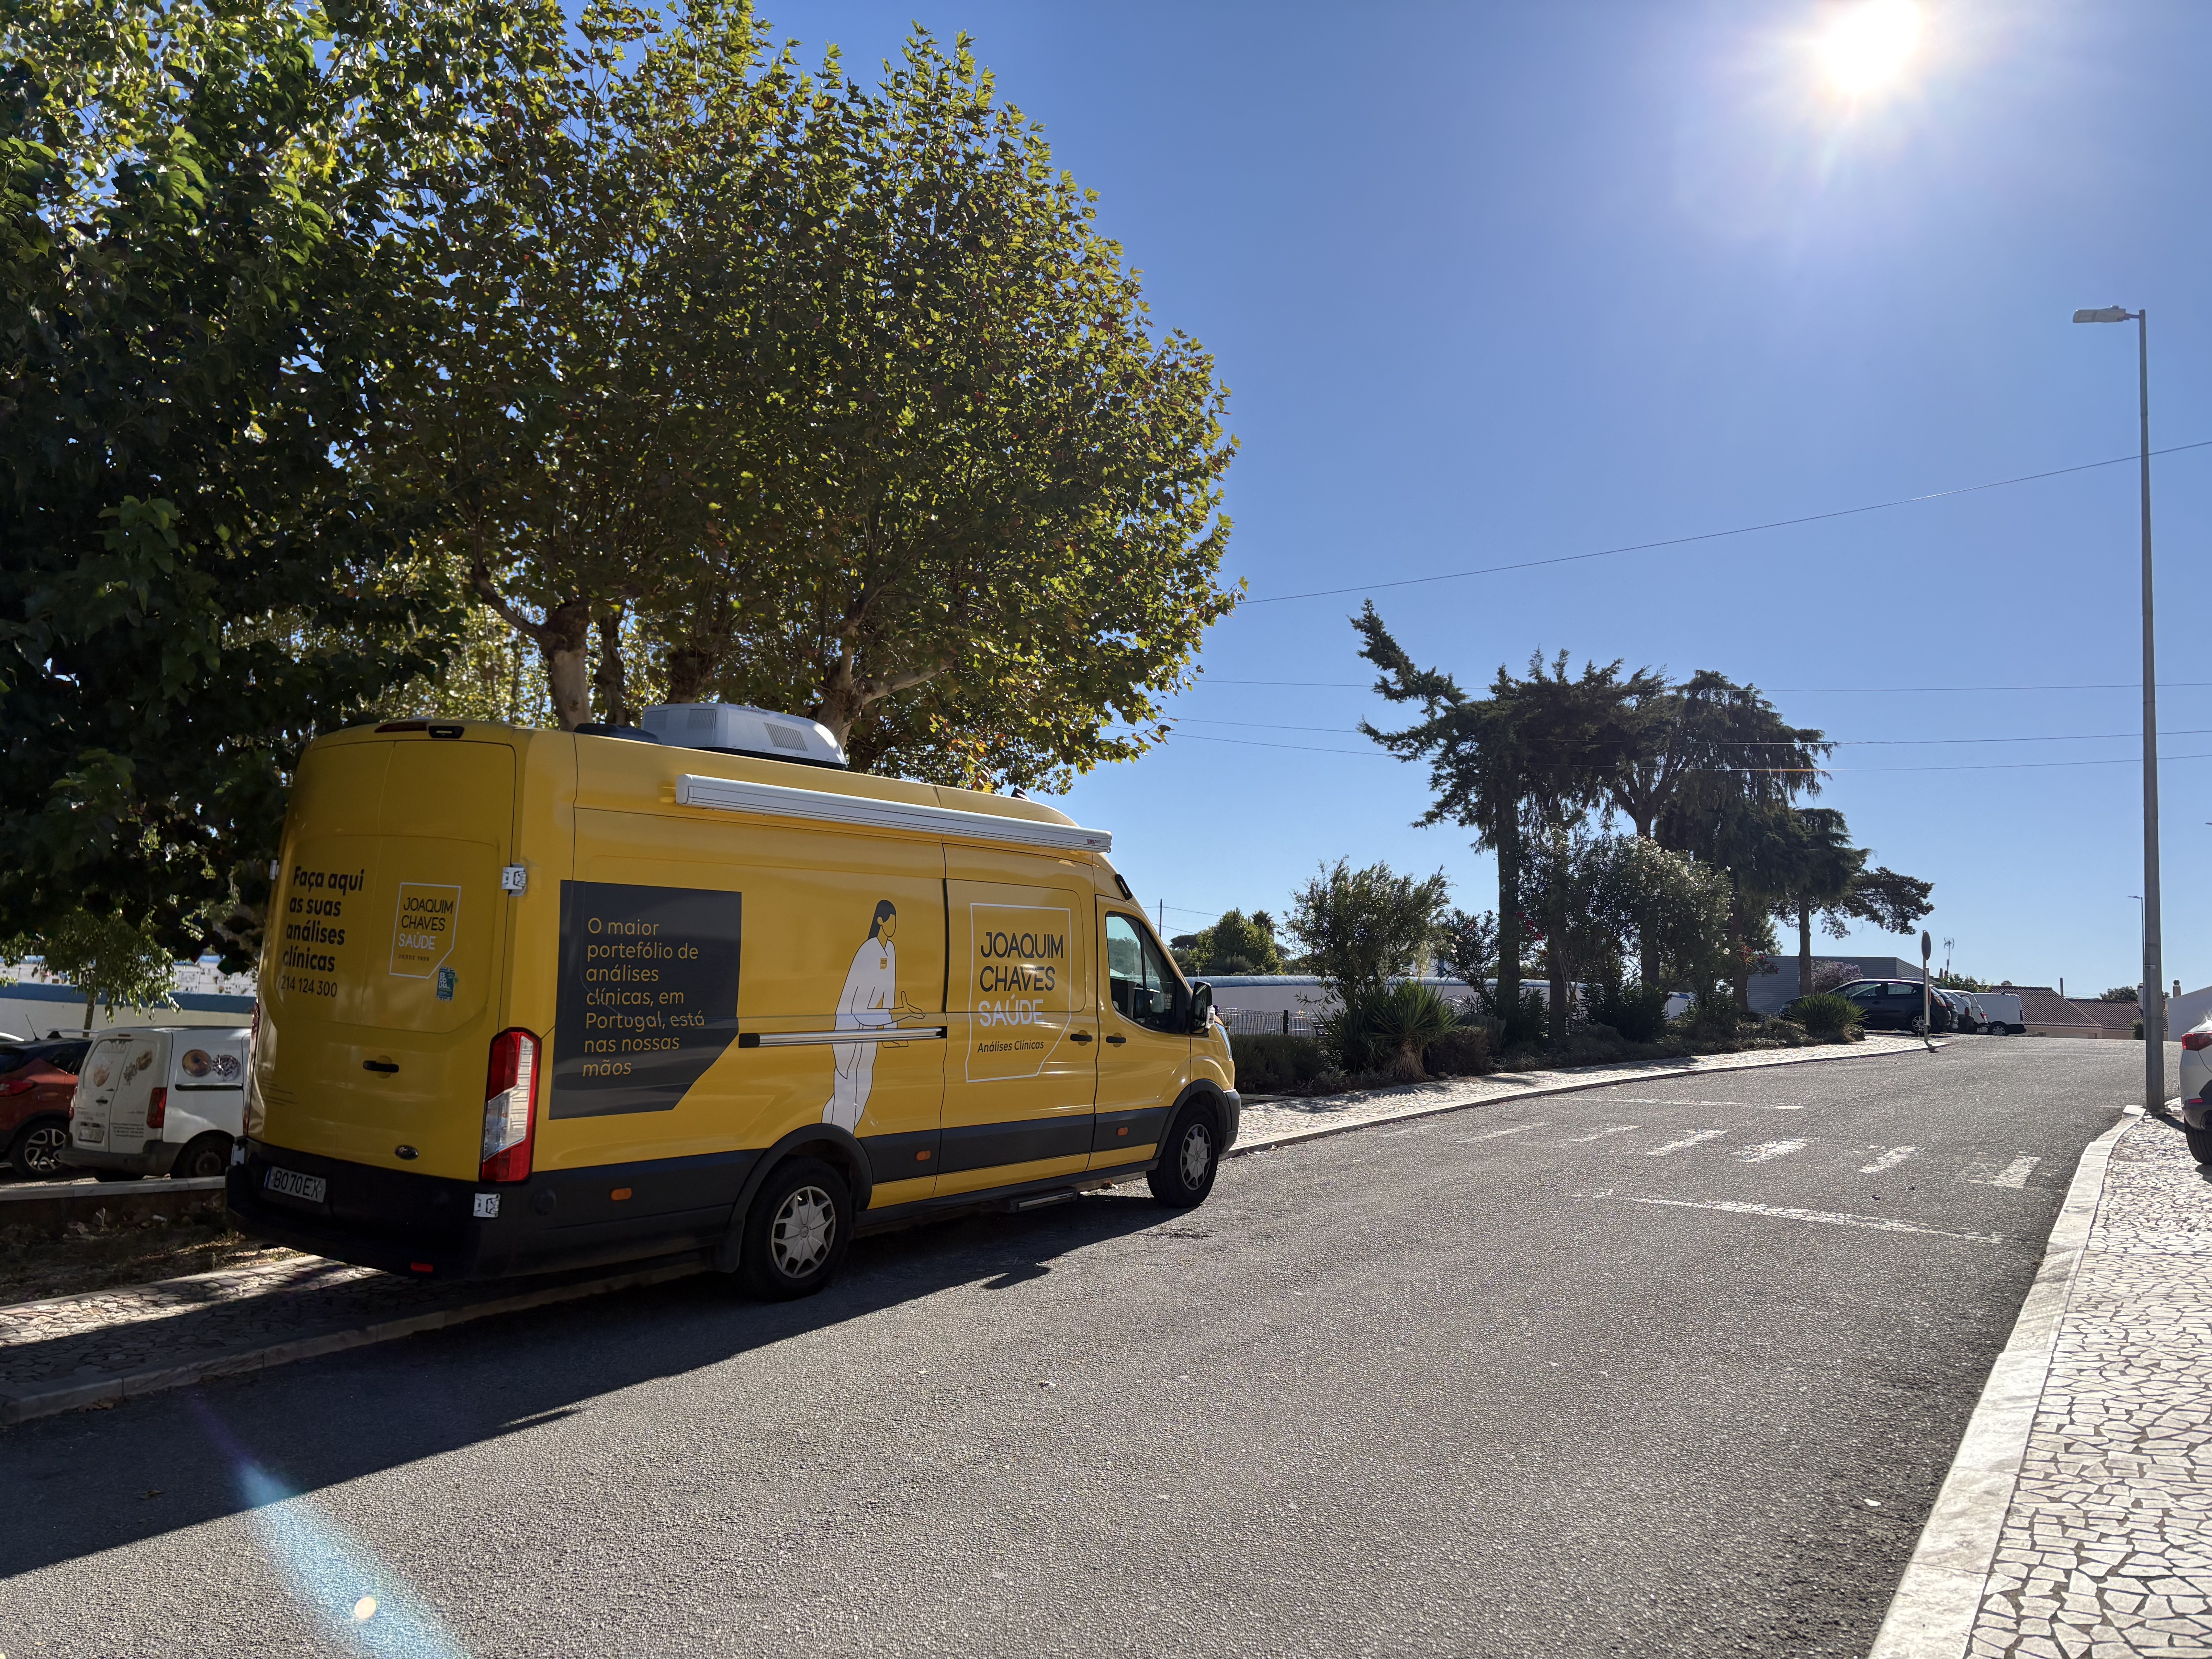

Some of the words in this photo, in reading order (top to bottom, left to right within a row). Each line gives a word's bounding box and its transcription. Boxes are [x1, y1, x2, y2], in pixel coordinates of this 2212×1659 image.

[294, 866, 325, 892] Faça
[328, 869, 365, 896] aqui
[290, 898, 304, 913] as
[306, 898, 342, 917] suas
[404, 897, 453, 914] JOAQUIM
[286, 920, 345, 945] análises
[402, 915, 446, 931] CHAVES
[588, 917, 602, 934] O
[608, 919, 659, 936] maior
[398, 932, 436, 950] SAÚDE
[981, 932, 1063, 958] JOAQUIM
[283, 945, 335, 972] clínicas
[587, 941, 673, 962] portefólio
[678, 943, 698, 959] de
[586, 964, 659, 981] análises
[980, 965, 1056, 992] CHAVES
[281, 975, 295, 991] 214
[299, 978, 314, 994] 124
[317, 981, 337, 998] 300
[587, 988, 653, 1007] clínicas,
[659, 992, 684, 1004] em
[978, 994, 1045, 1027] SAÚDE
[586, 1011, 665, 1032] Portugal,
[670, 1010, 705, 1027] está
[585, 1039, 617, 1053] nas
[622, 1037, 680, 1051] nossas
[977, 1041, 1012, 1053] Análises
[1015, 1039, 1044, 1050] Clínicas
[582, 1059, 632, 1077] mãos
